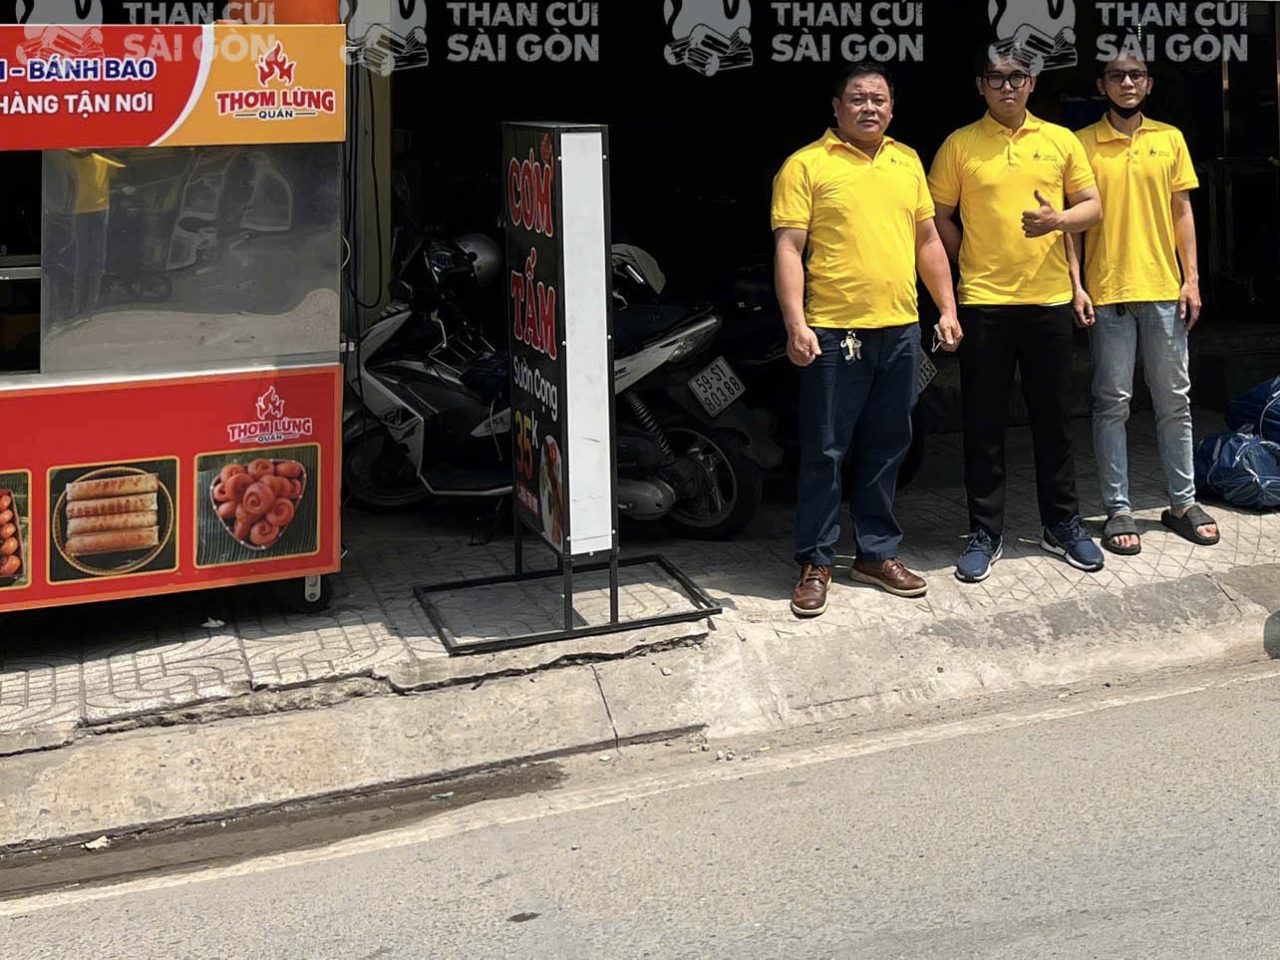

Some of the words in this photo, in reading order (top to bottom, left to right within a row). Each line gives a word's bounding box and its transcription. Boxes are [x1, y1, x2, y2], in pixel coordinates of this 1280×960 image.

[29, 55, 99, 81] BÁNH
[104, 58, 157, 80] BAO
[64, 92, 111, 118] TẬN
[115, 91, 154, 113] NƠI
[216, 90, 277, 115] THƠM
[258, 107, 293, 120] QUÁN
[508, 147, 554, 237] CƠM
[534, 368, 558, 422] Cọng
